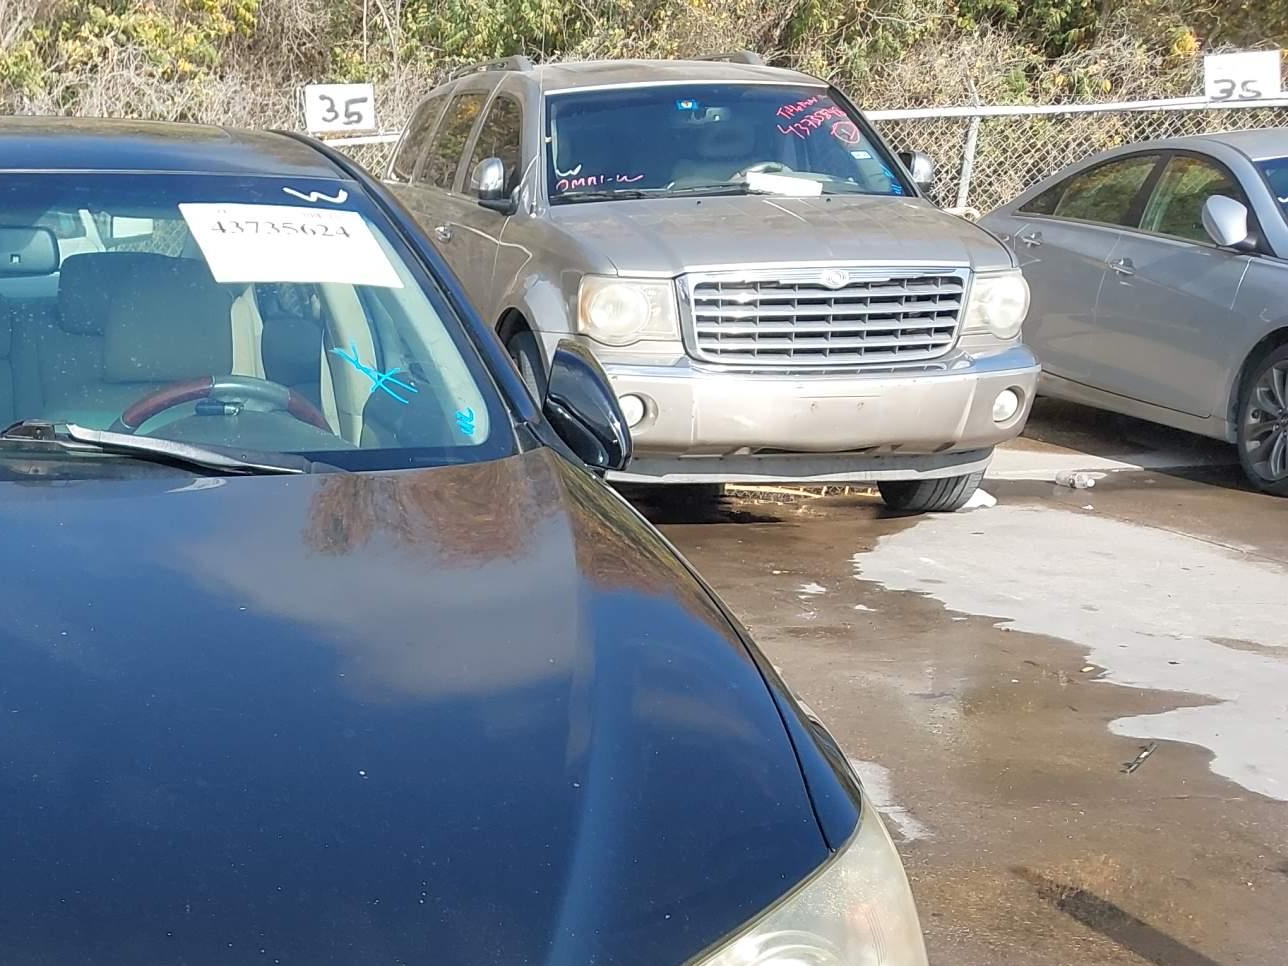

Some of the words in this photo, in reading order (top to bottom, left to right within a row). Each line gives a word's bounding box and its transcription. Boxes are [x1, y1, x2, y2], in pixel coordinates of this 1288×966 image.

[1210, 79, 1262, 100] 35
[318, 94, 368, 125] 35
[211, 220, 351, 239] 43735624
